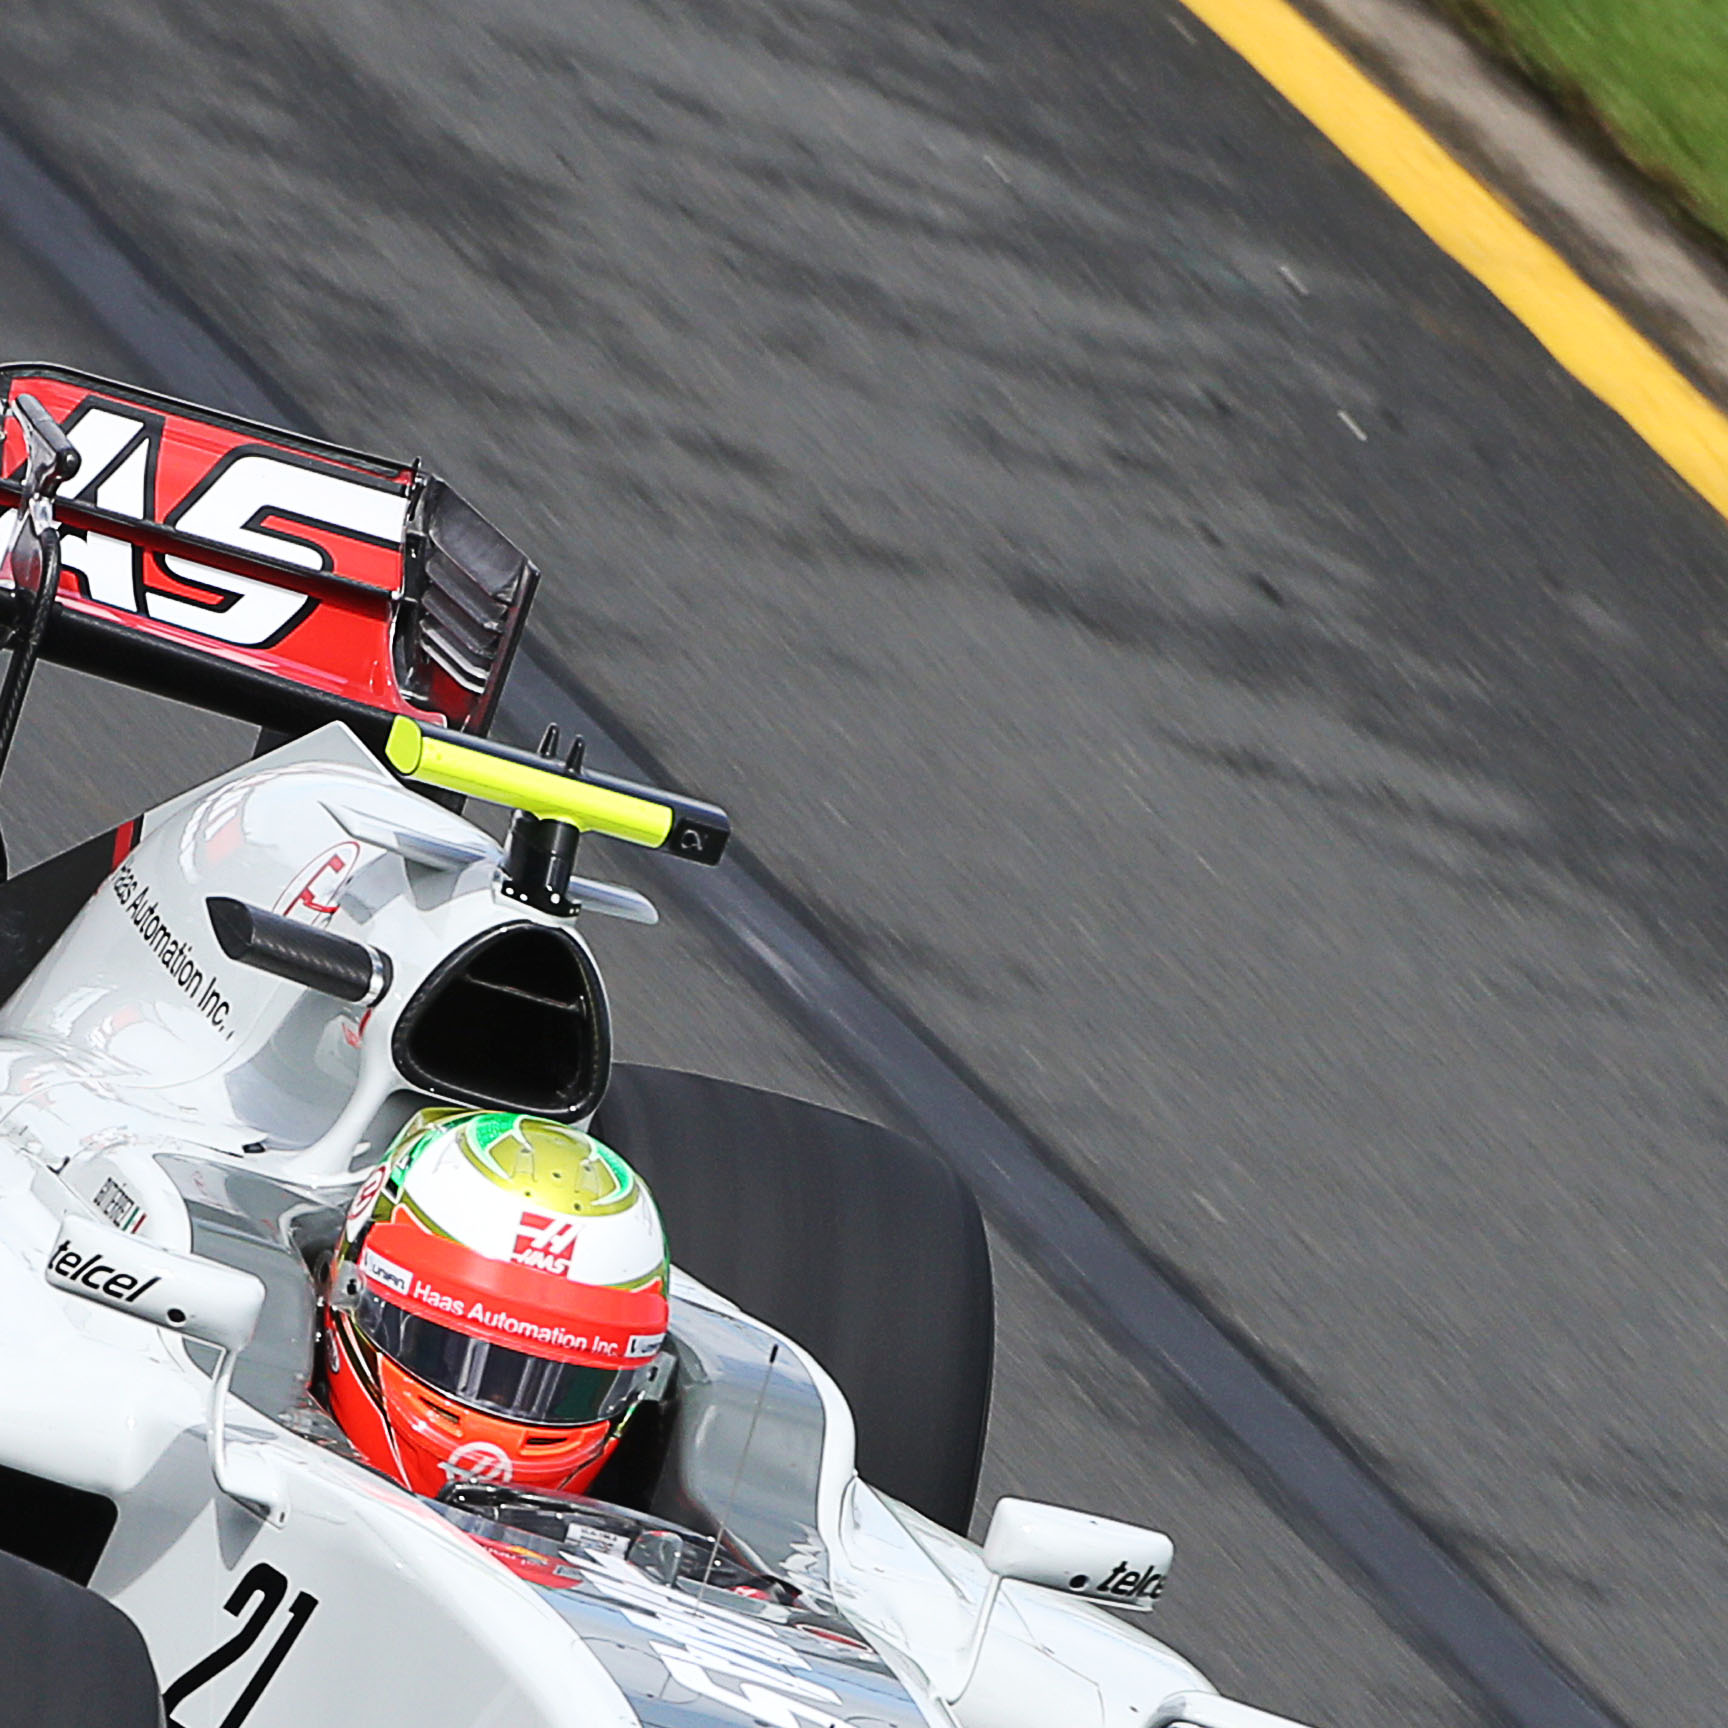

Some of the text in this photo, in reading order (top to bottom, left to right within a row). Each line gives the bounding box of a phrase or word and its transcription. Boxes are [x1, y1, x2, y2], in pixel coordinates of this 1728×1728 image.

[125, 886, 203, 999] Automation
[48, 1240, 162, 1303] telcel
[413, 1280, 465, 1316] Haas
[467, 1302, 588, 1350] Automation
